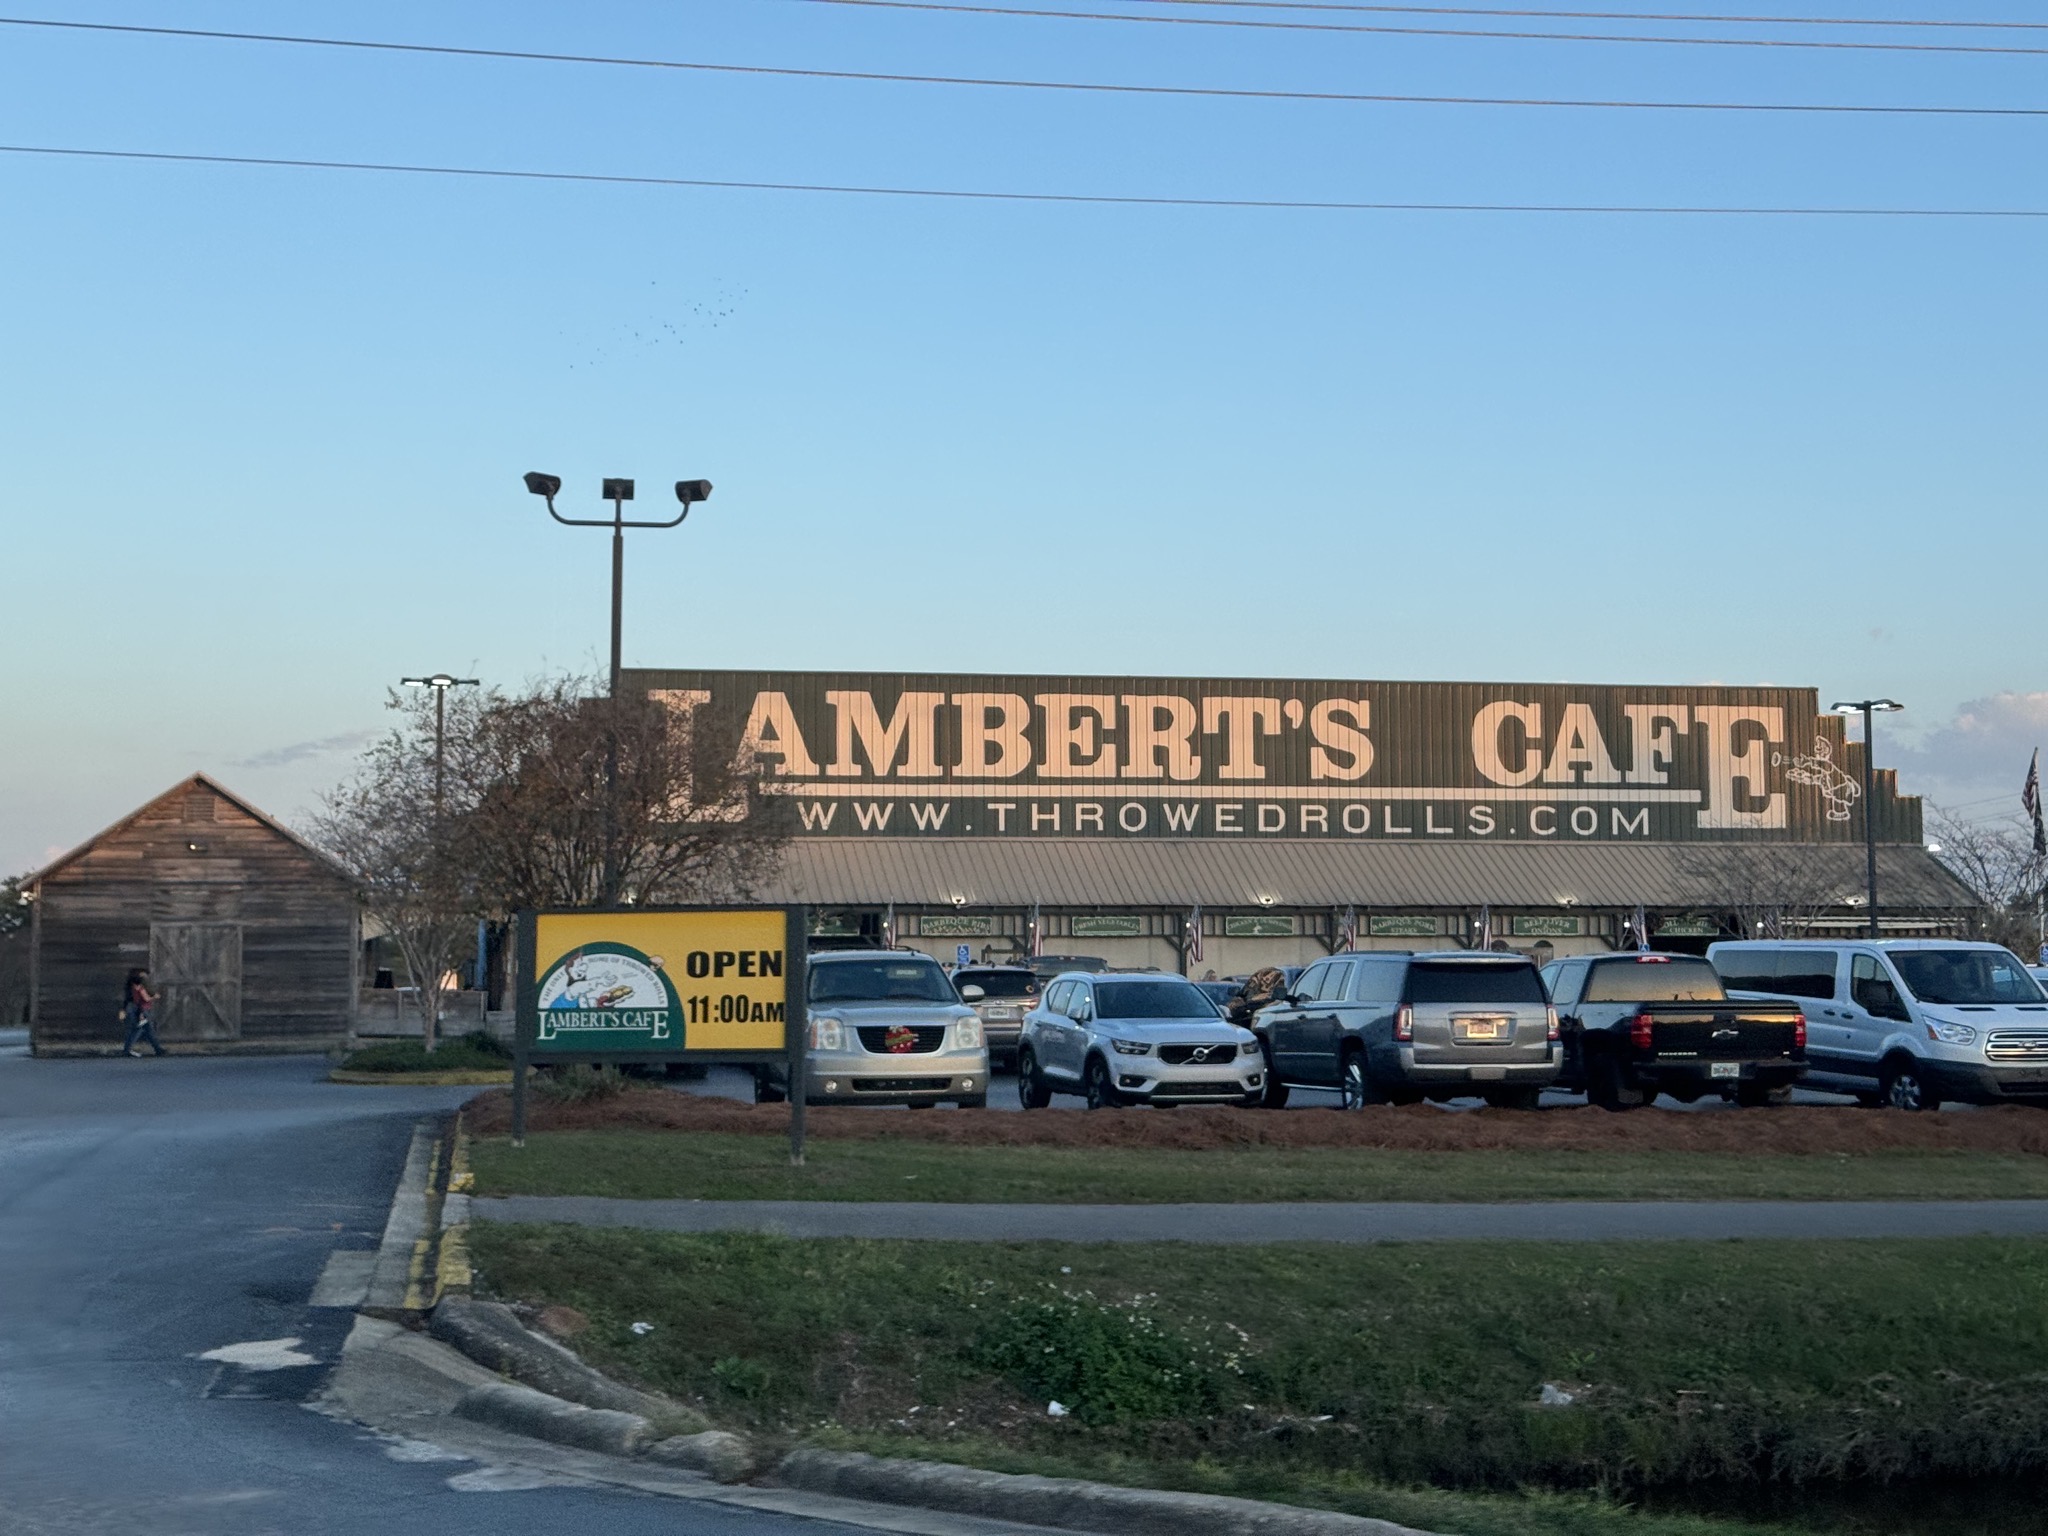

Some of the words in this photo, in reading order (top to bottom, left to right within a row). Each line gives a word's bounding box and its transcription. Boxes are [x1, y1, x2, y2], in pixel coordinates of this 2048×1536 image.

[649, 689, 1374, 824] LAMBERT'S
[1471, 699, 1786, 829] CAFE
[796, 800, 1651, 836] WWW.THROWEDROLLS.COM
[686, 950, 783, 978] OPEN
[687, 993, 785, 1023] 11:00AM
[537, 1011, 620, 1040] LAMBERT'S
[622, 1010, 671, 1040] CAFE
